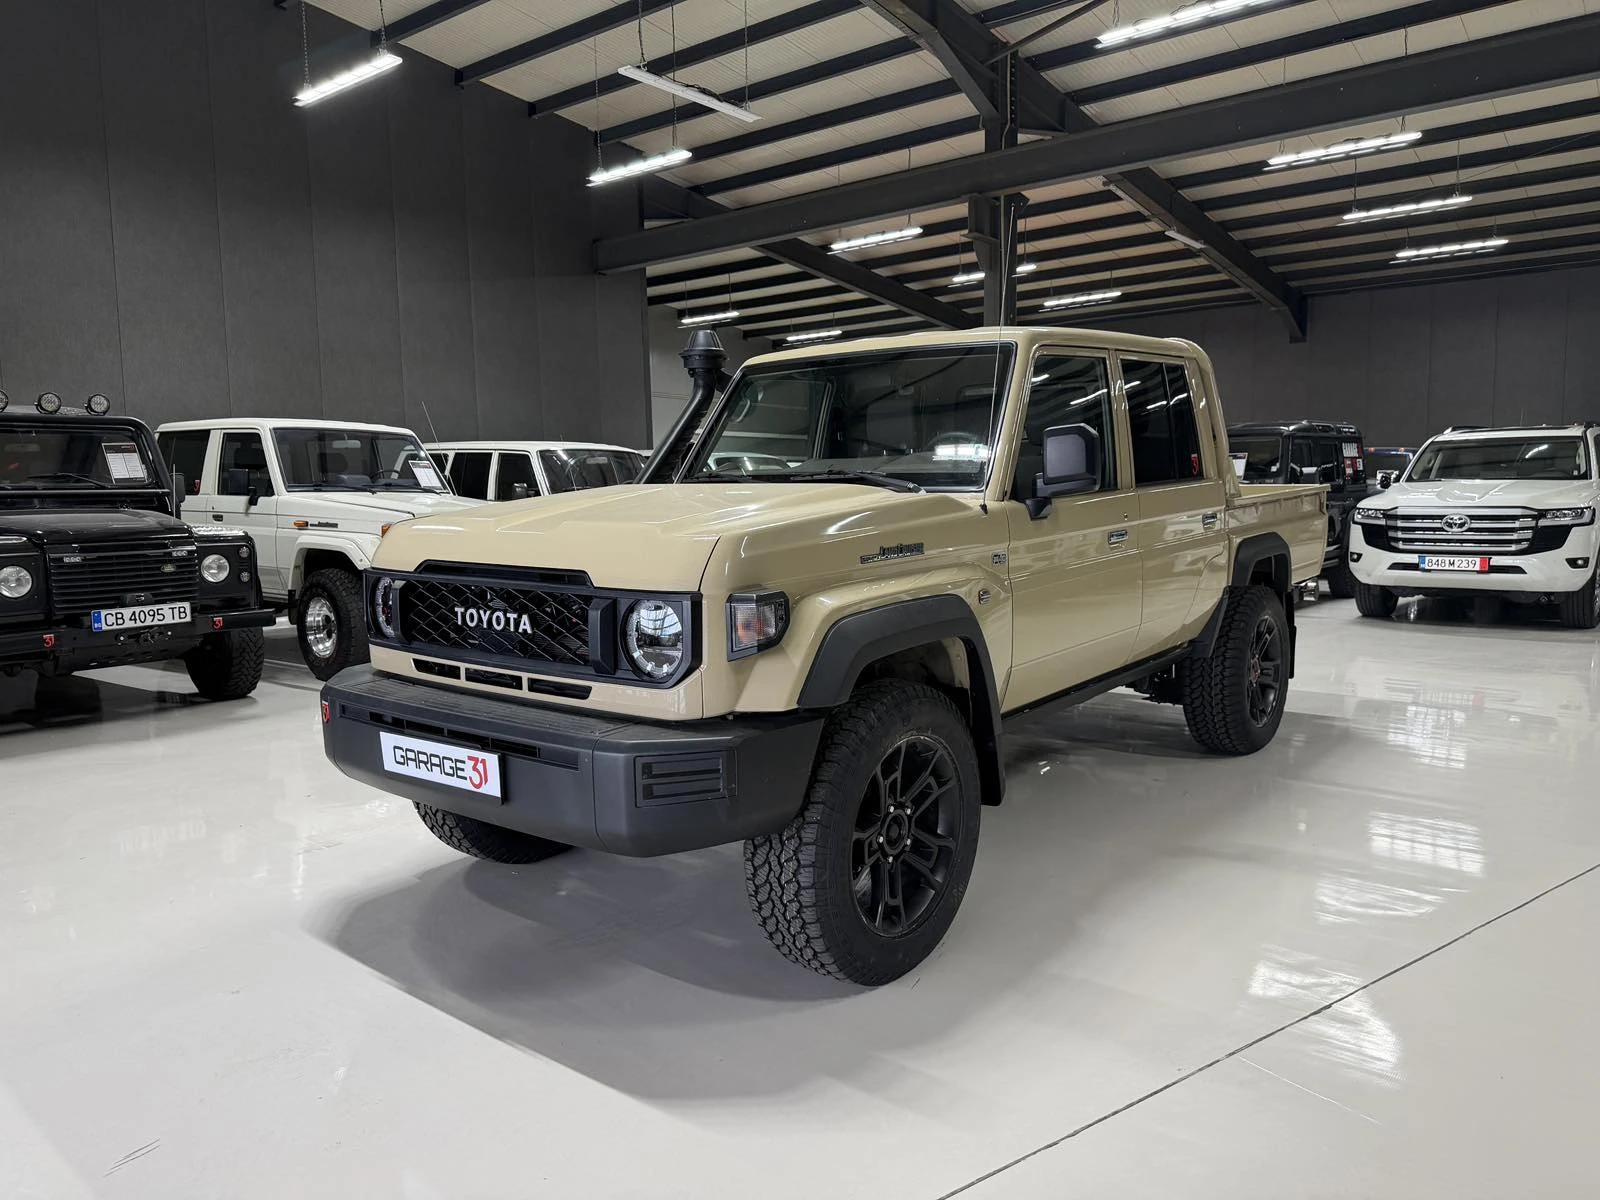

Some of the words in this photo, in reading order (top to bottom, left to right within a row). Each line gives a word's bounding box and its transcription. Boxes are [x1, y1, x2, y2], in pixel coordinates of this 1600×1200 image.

[1427, 558, 1446, 568] 848
[1448, 559, 1455, 568] M
[1457, 559, 1477, 568] 239
[104, 612, 125, 627] CB
[129, 608, 166, 624] 4095
[168, 606, 187, 620] TB
[455, 607, 532, 634] TOYOTA
